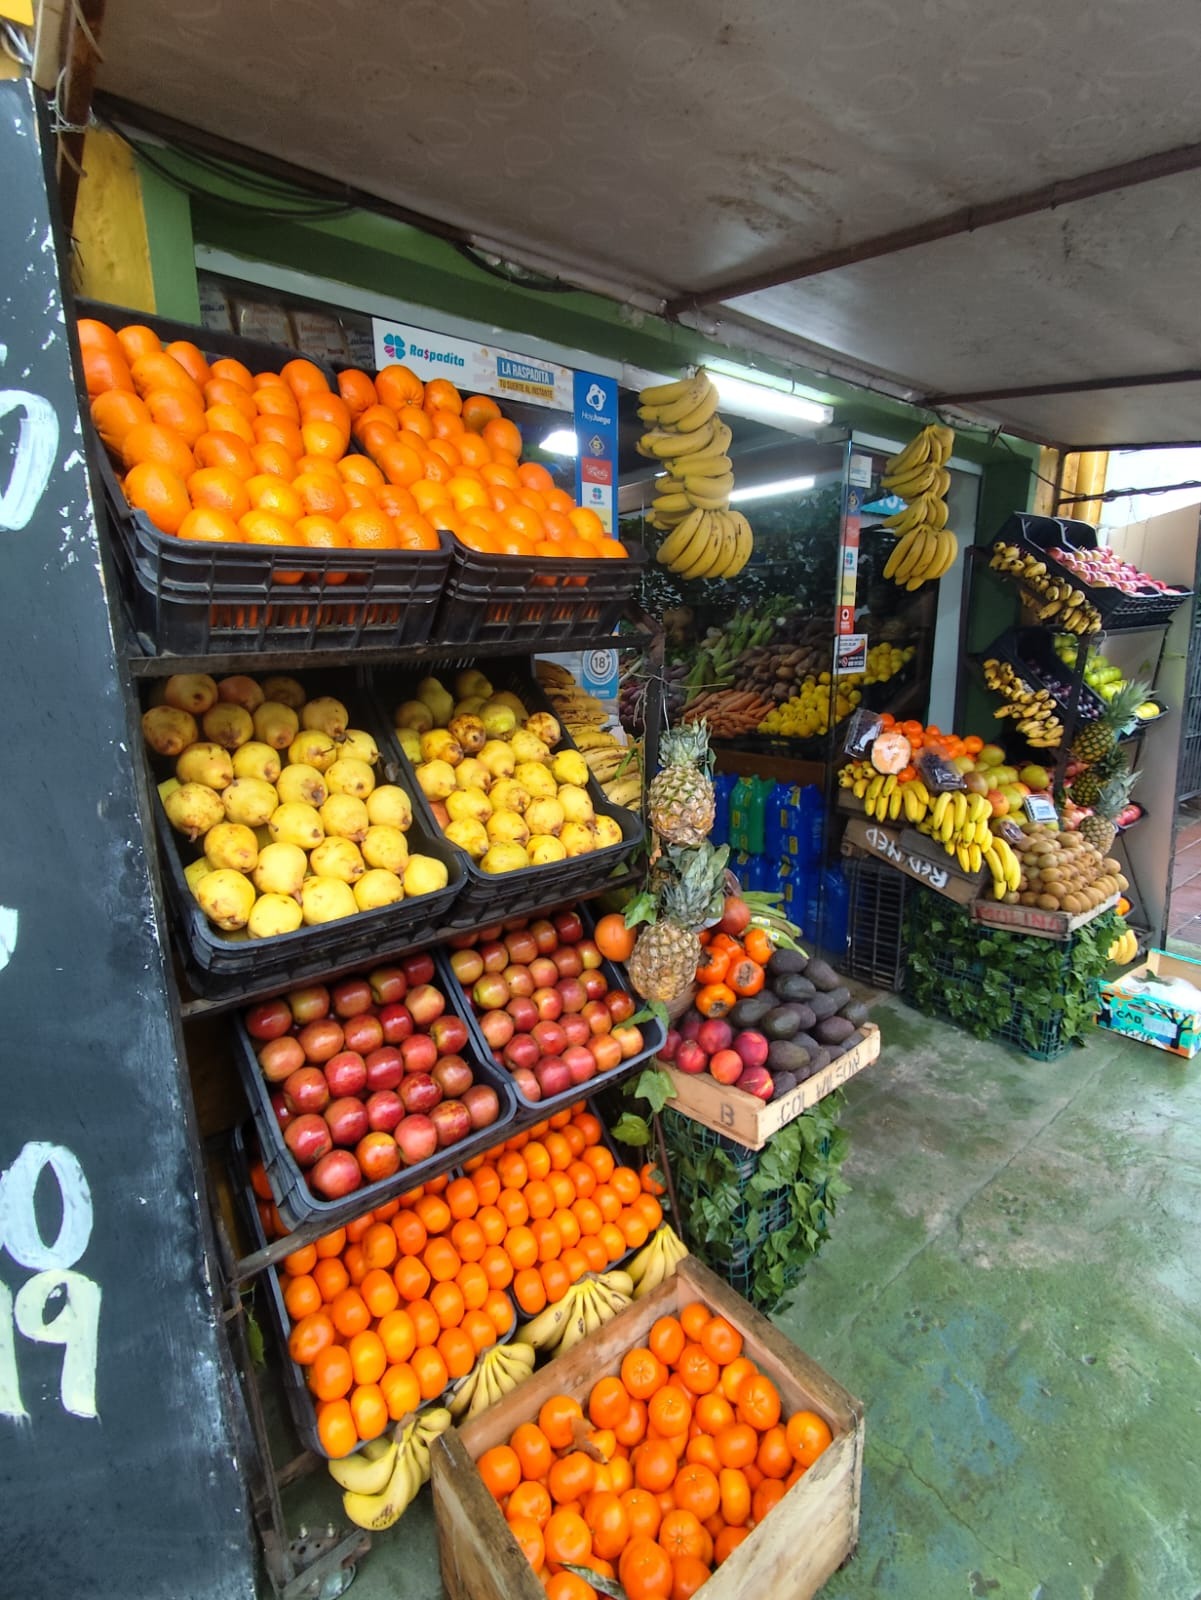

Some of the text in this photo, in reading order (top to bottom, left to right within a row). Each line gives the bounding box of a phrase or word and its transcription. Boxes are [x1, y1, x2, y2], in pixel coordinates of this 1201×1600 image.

[501, 361, 550, 385] LA RASPADITA
[594, 656, 606, 669] 18
[976, 904, 1063, 934] MOLINA
[720, 1102, 735, 1127] B
